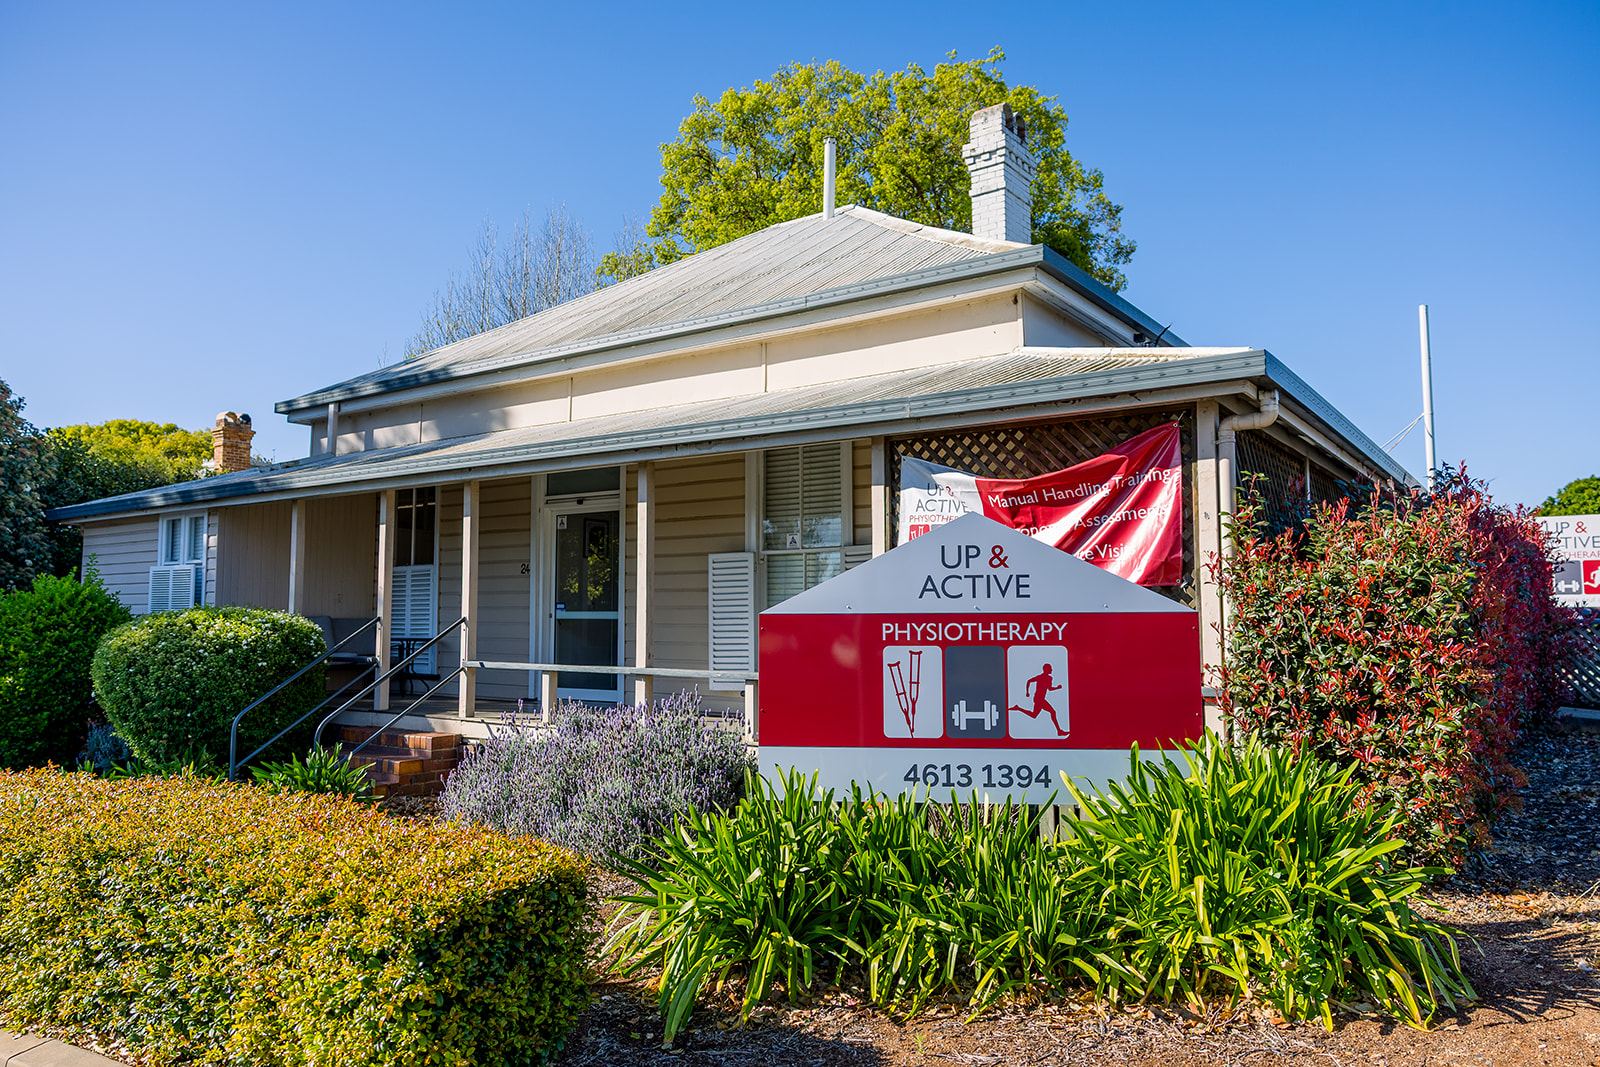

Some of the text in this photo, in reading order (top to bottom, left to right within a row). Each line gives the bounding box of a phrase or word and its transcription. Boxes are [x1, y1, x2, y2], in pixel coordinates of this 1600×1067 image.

[988, 467, 1171, 508] Manual Handling Training
[915, 498, 970, 513] ACTIVE
[908, 514, 960, 523] PHYSIOTHE
[1545, 521, 1587, 534] UP &
[940, 544, 1009, 569] UP &
[520, 562, 531, 574] 24
[918, 574, 1031, 599] ACTIVE
[882, 622, 1068, 642] PHYSIOTHERAPY
[903, 763, 1052, 789] 4613 1394
